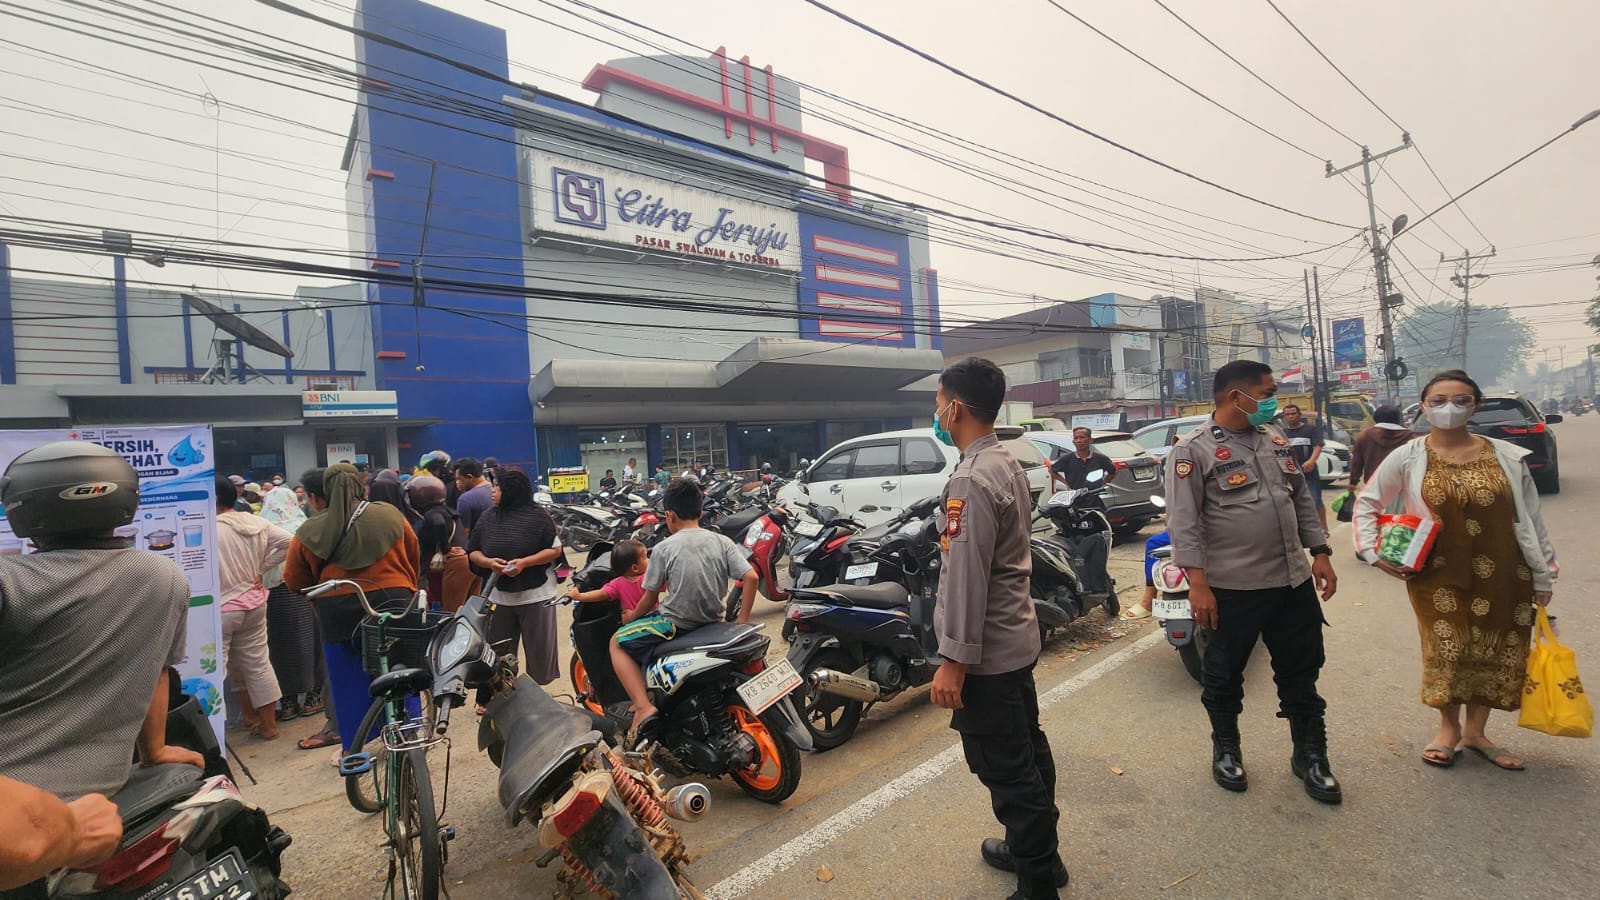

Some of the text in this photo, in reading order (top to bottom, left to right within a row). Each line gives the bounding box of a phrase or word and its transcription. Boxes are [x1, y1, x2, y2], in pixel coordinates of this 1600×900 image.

[614, 186, 789, 256] Citra Jeruju
[635, 234, 780, 266] PASAR SWALAYAN & TOSERBA
[320, 393, 340, 402] BNI
[74, 485, 108, 495] GM
[553, 478, 560, 488] P
[744, 684, 758, 700] KB
[757, 672, 778, 690] 2640
[137, 881, 169, 900] HONDA
